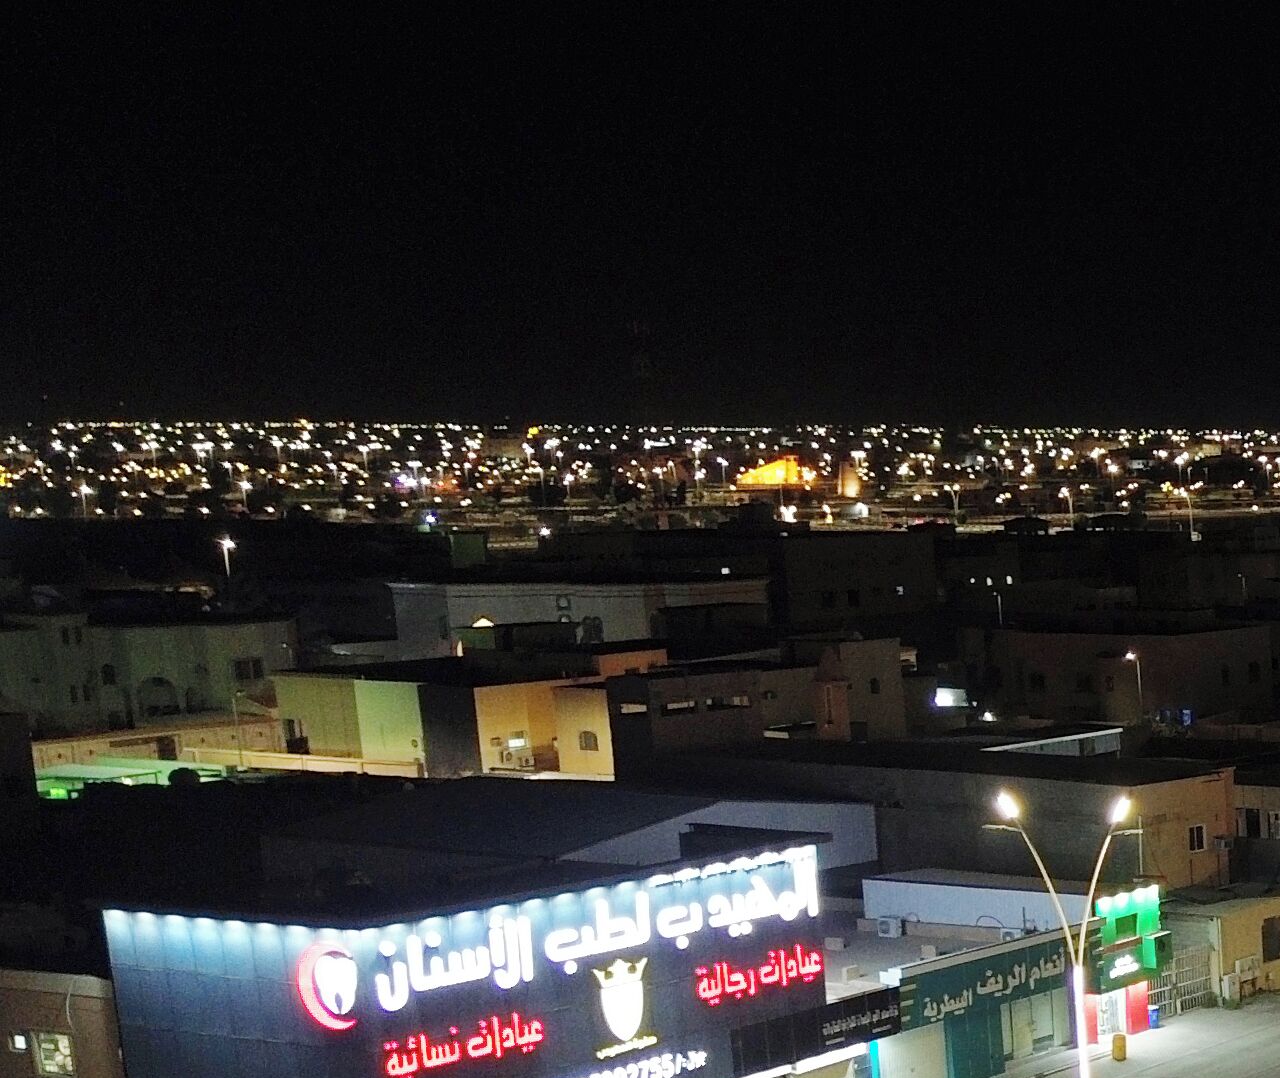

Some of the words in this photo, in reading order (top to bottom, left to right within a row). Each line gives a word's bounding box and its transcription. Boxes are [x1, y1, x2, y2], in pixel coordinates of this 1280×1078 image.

[545, 891, 651, 974] لطب
[375, 914, 534, 1012] الأسنان
[695, 961, 756, 1006] رجالية
[759, 944, 822, 986] عيادات
[976, 962, 1026, 997] الريف
[467, 1010, 544, 1058] عيادات
